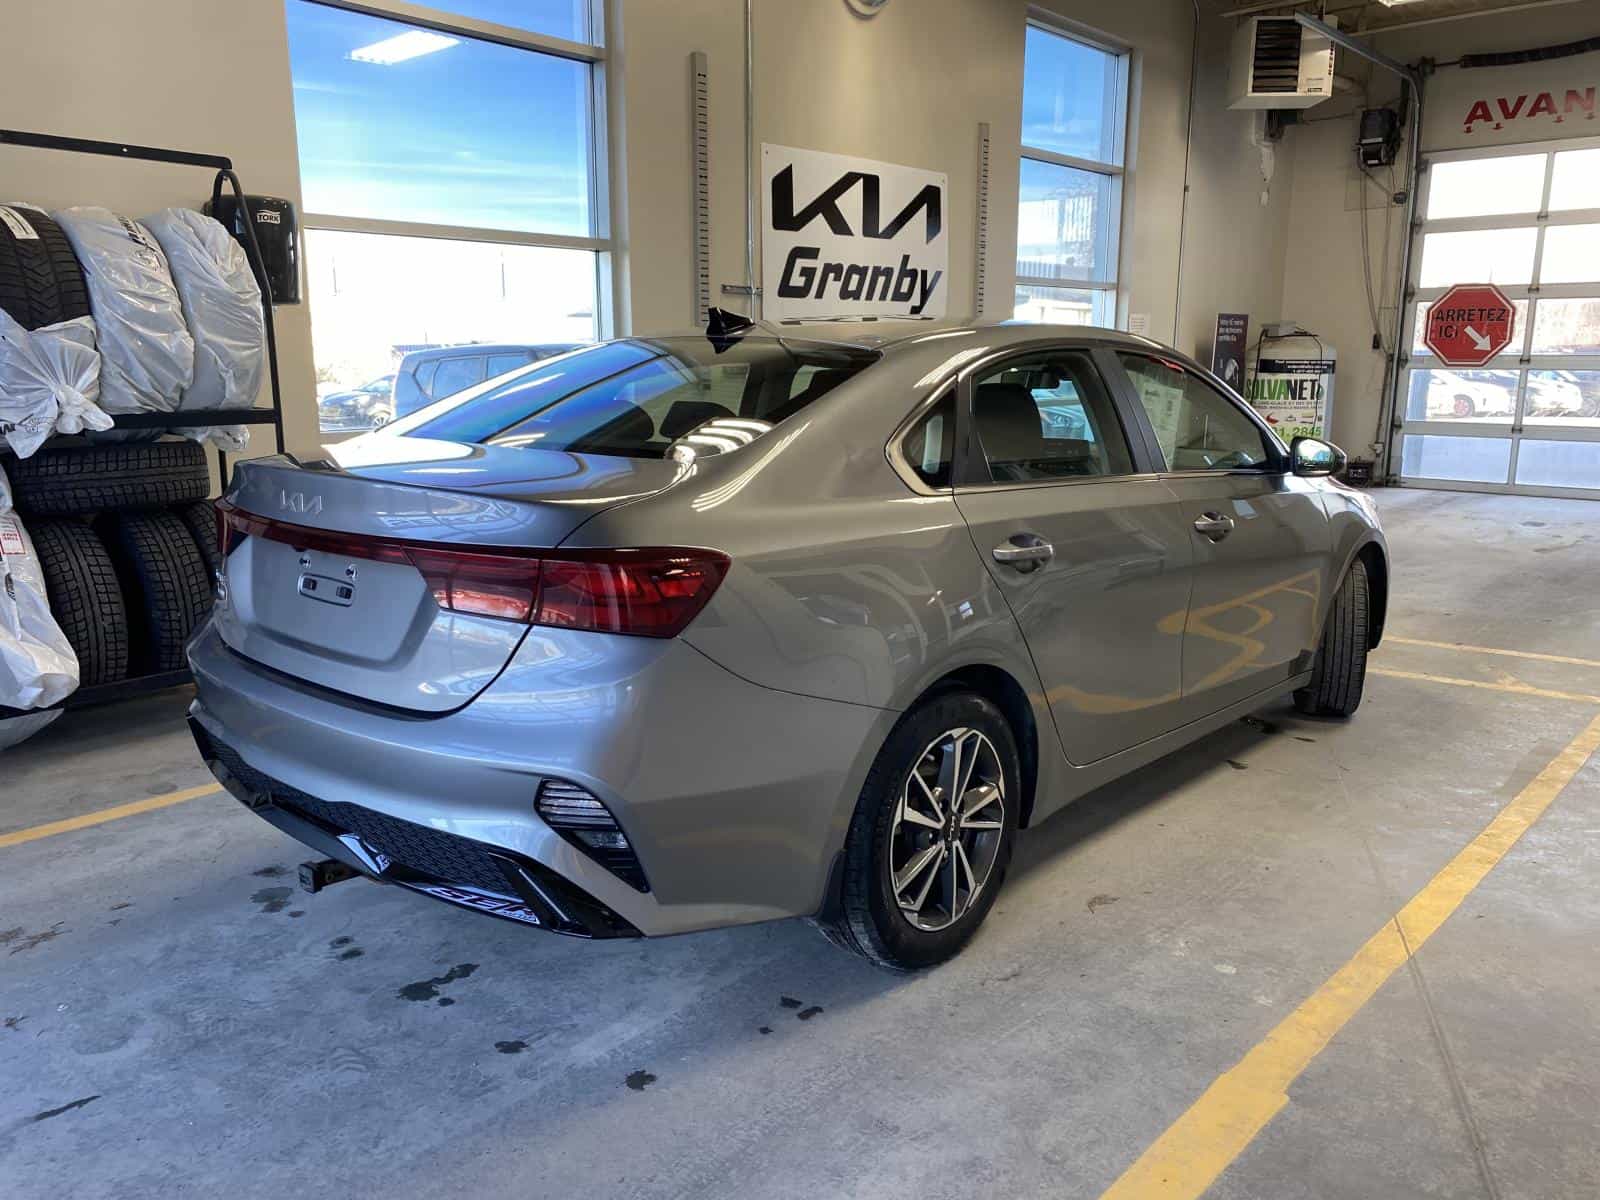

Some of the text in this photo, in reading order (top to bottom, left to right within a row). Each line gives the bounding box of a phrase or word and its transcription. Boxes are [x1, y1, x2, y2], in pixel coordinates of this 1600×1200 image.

[258, 214, 280, 222] TORK
[771, 163, 942, 244] KIA
[777, 246, 943, 314] Granby
[280, 488, 322, 516] KIA
